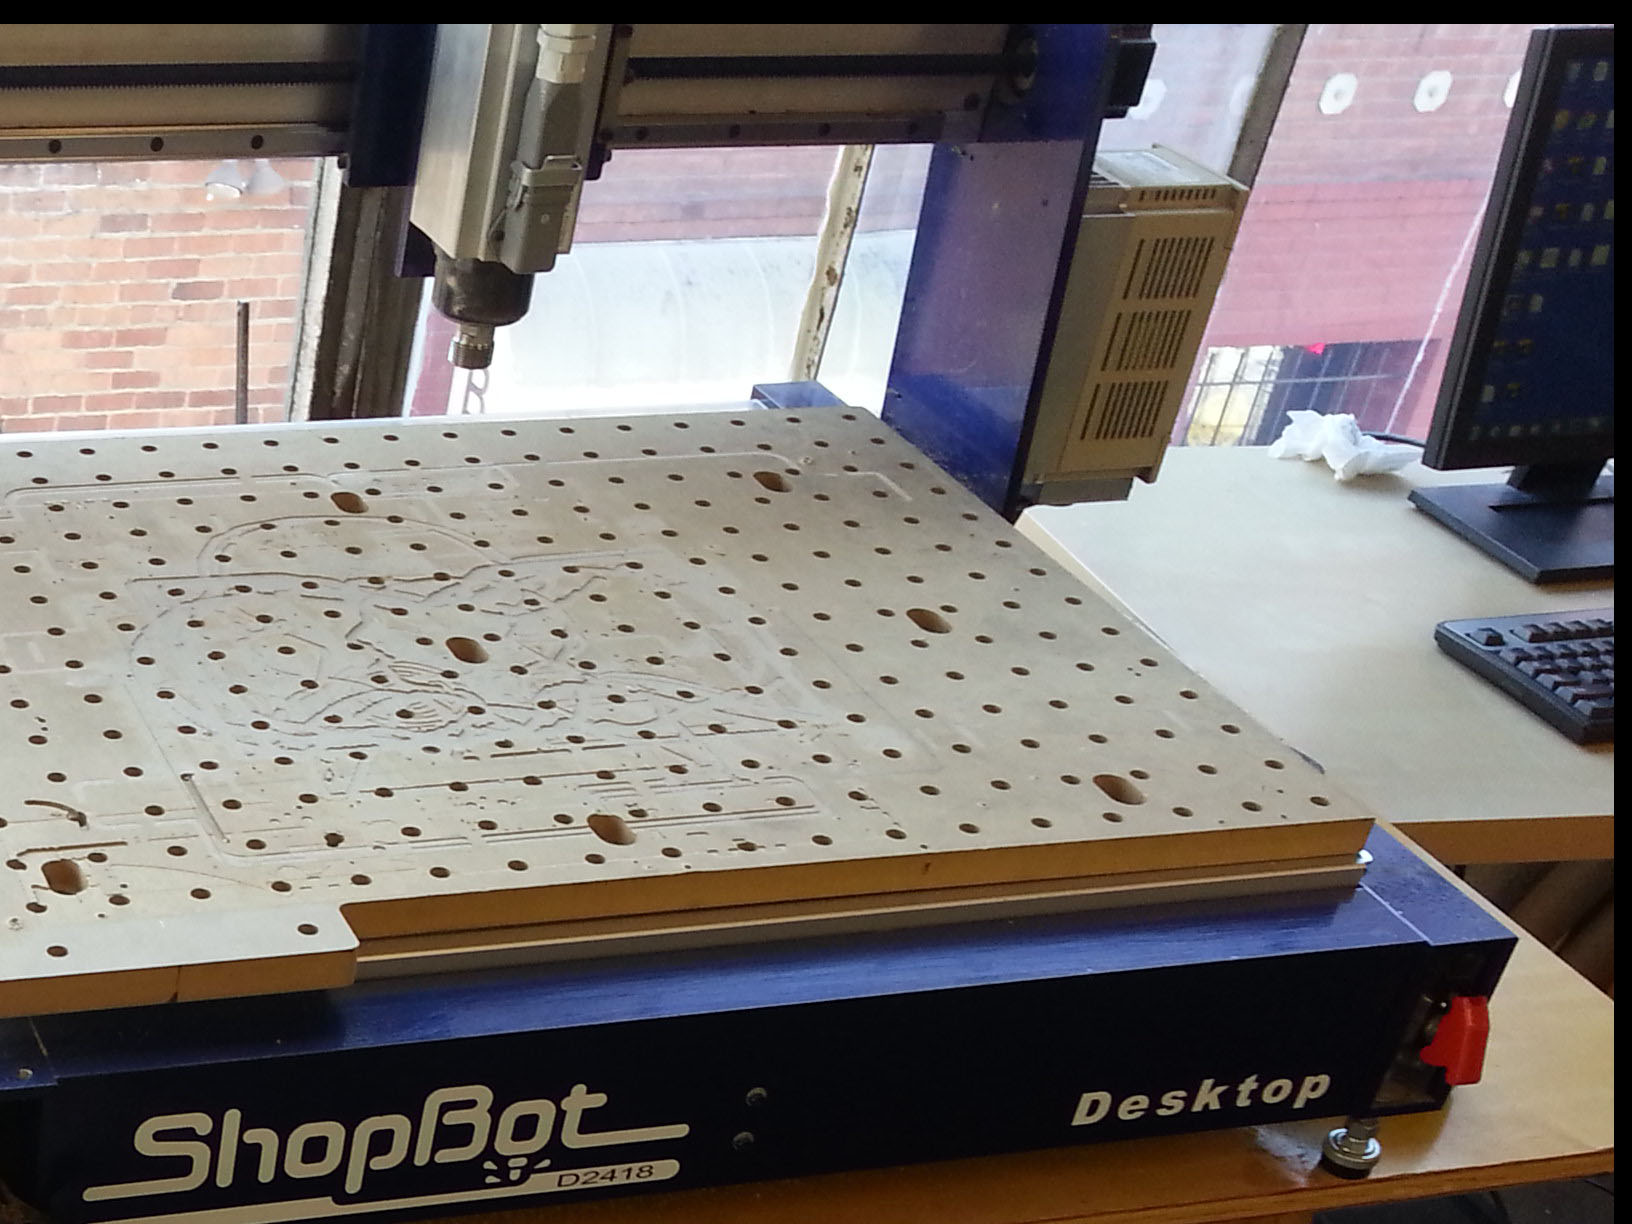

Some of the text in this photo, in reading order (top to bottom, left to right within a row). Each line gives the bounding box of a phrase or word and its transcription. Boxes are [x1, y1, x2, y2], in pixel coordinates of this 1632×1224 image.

[1070, 1072, 1332, 1127] Desktop
[82, 1083, 690, 1202] ShopBot
[556, 1164, 655, 1188] D2418
